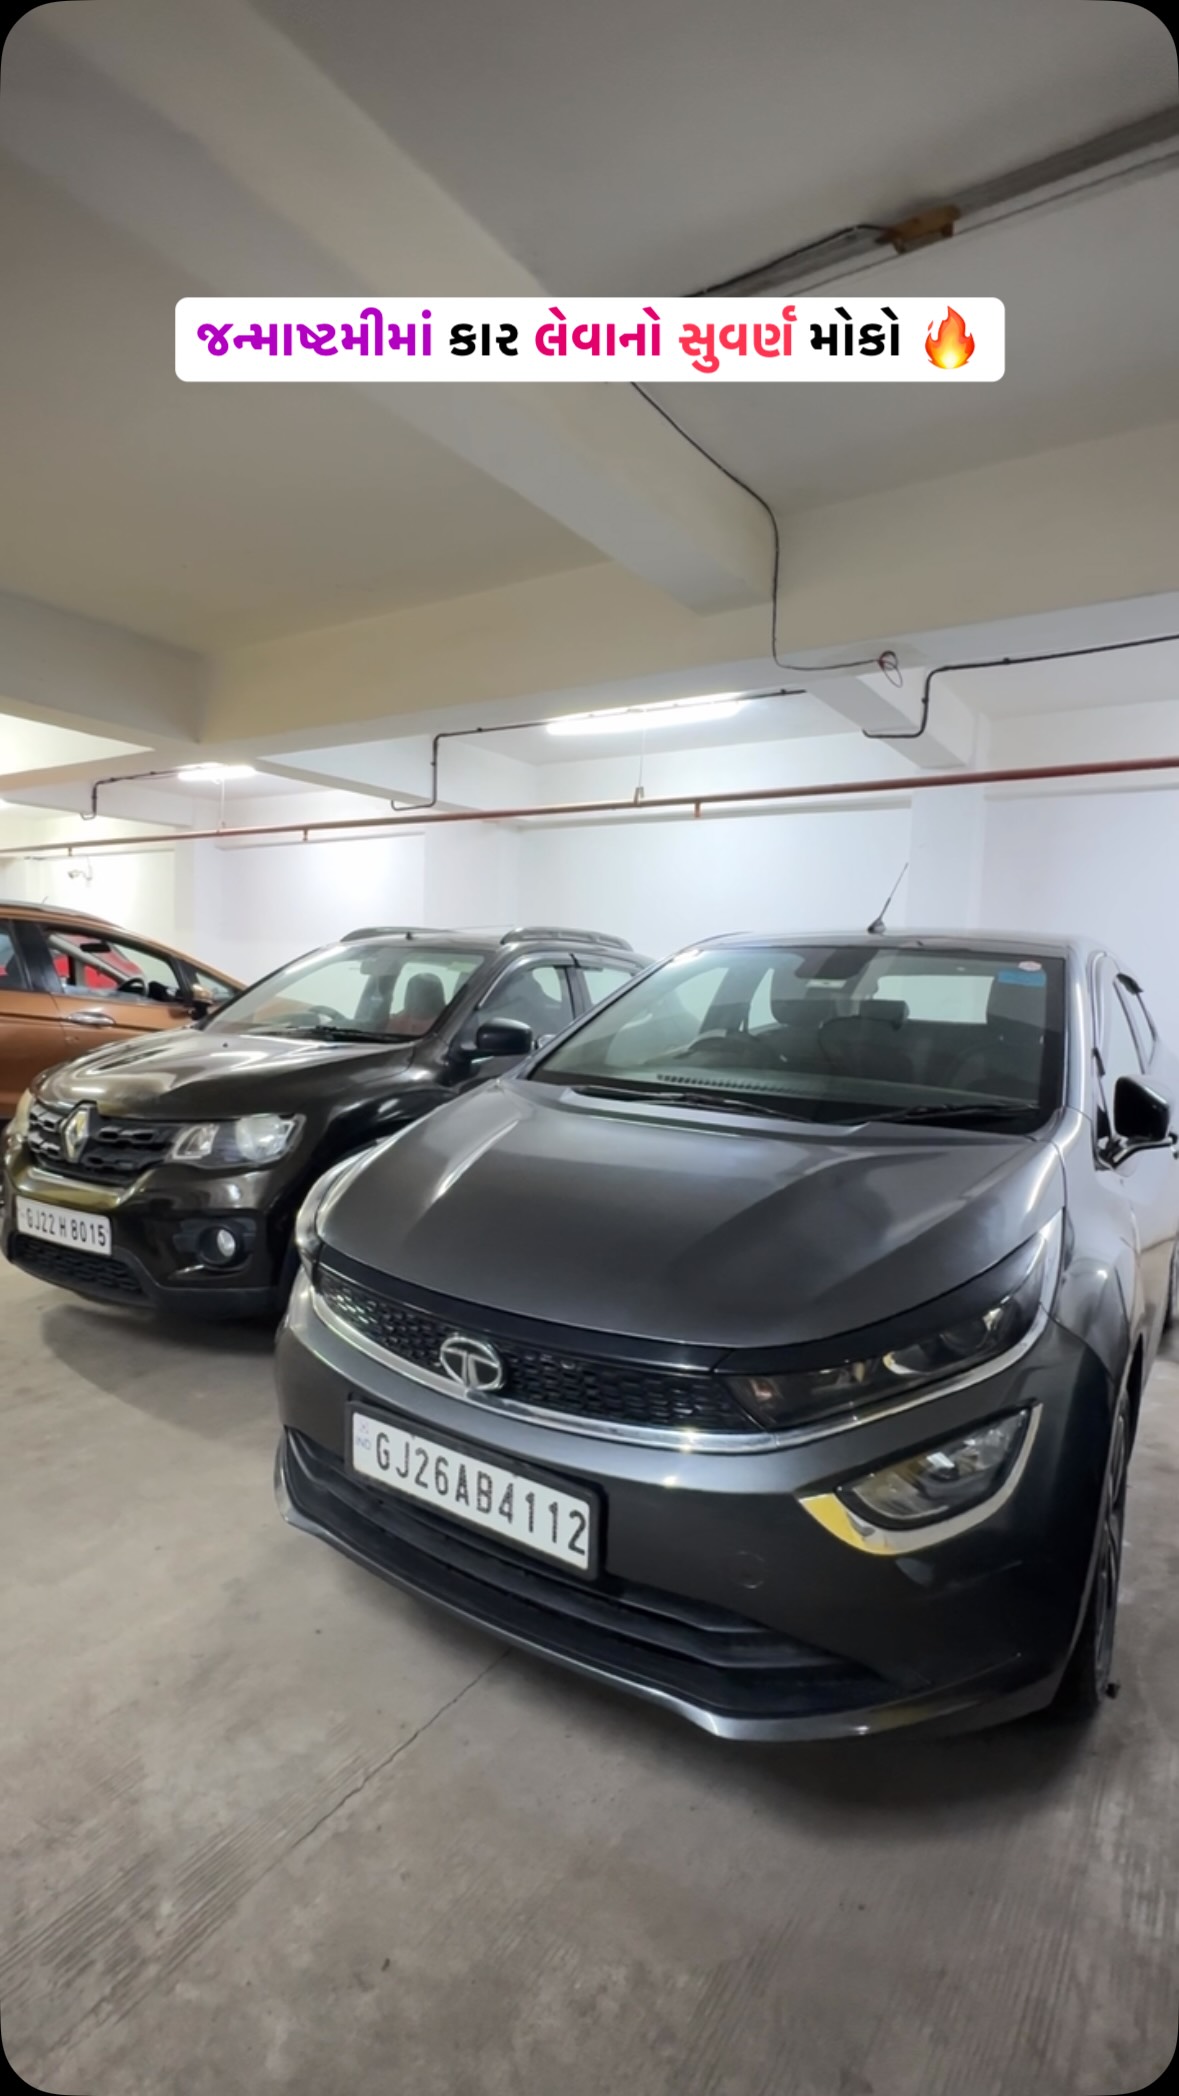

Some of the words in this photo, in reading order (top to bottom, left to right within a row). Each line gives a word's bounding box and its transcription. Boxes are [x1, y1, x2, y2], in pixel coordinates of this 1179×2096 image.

[26, 1208, 55, 1235] GJ22
[59, 1217, 67, 1238] H
[71, 1220, 106, 1246] 8015
[376, 1432, 587, 1555] GJ26AB4112
